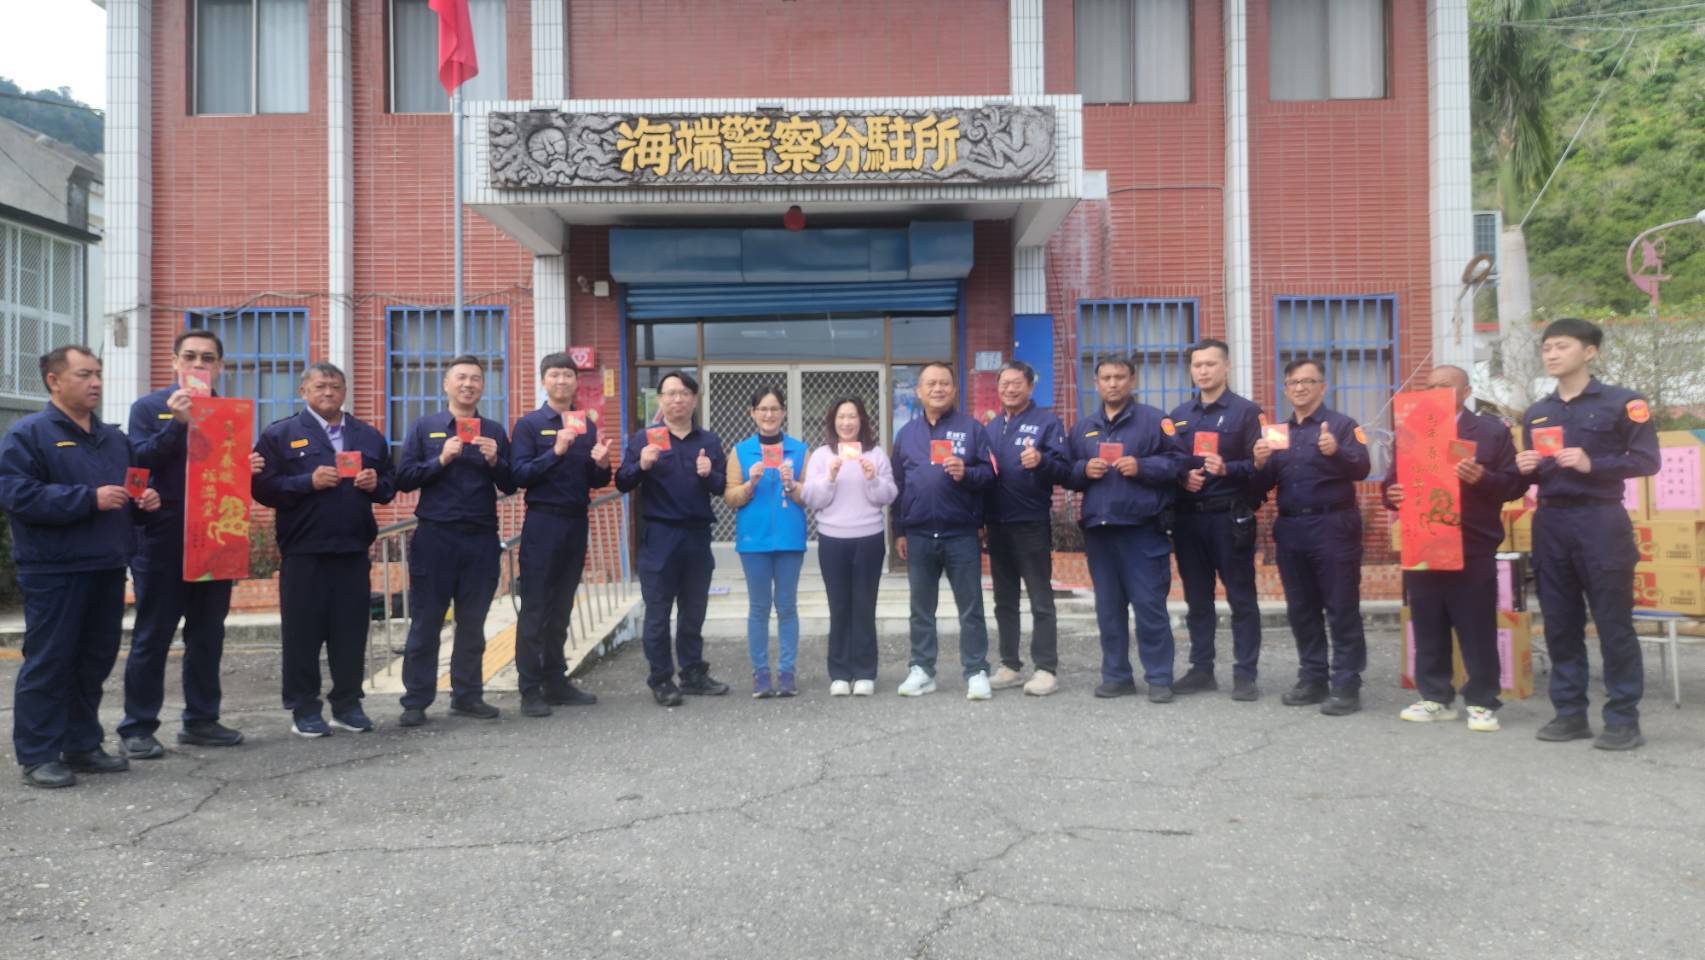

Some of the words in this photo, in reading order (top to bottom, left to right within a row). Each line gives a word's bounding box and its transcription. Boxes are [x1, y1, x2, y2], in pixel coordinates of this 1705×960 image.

[617, 116, 961, 176] 海端警察分駐所
